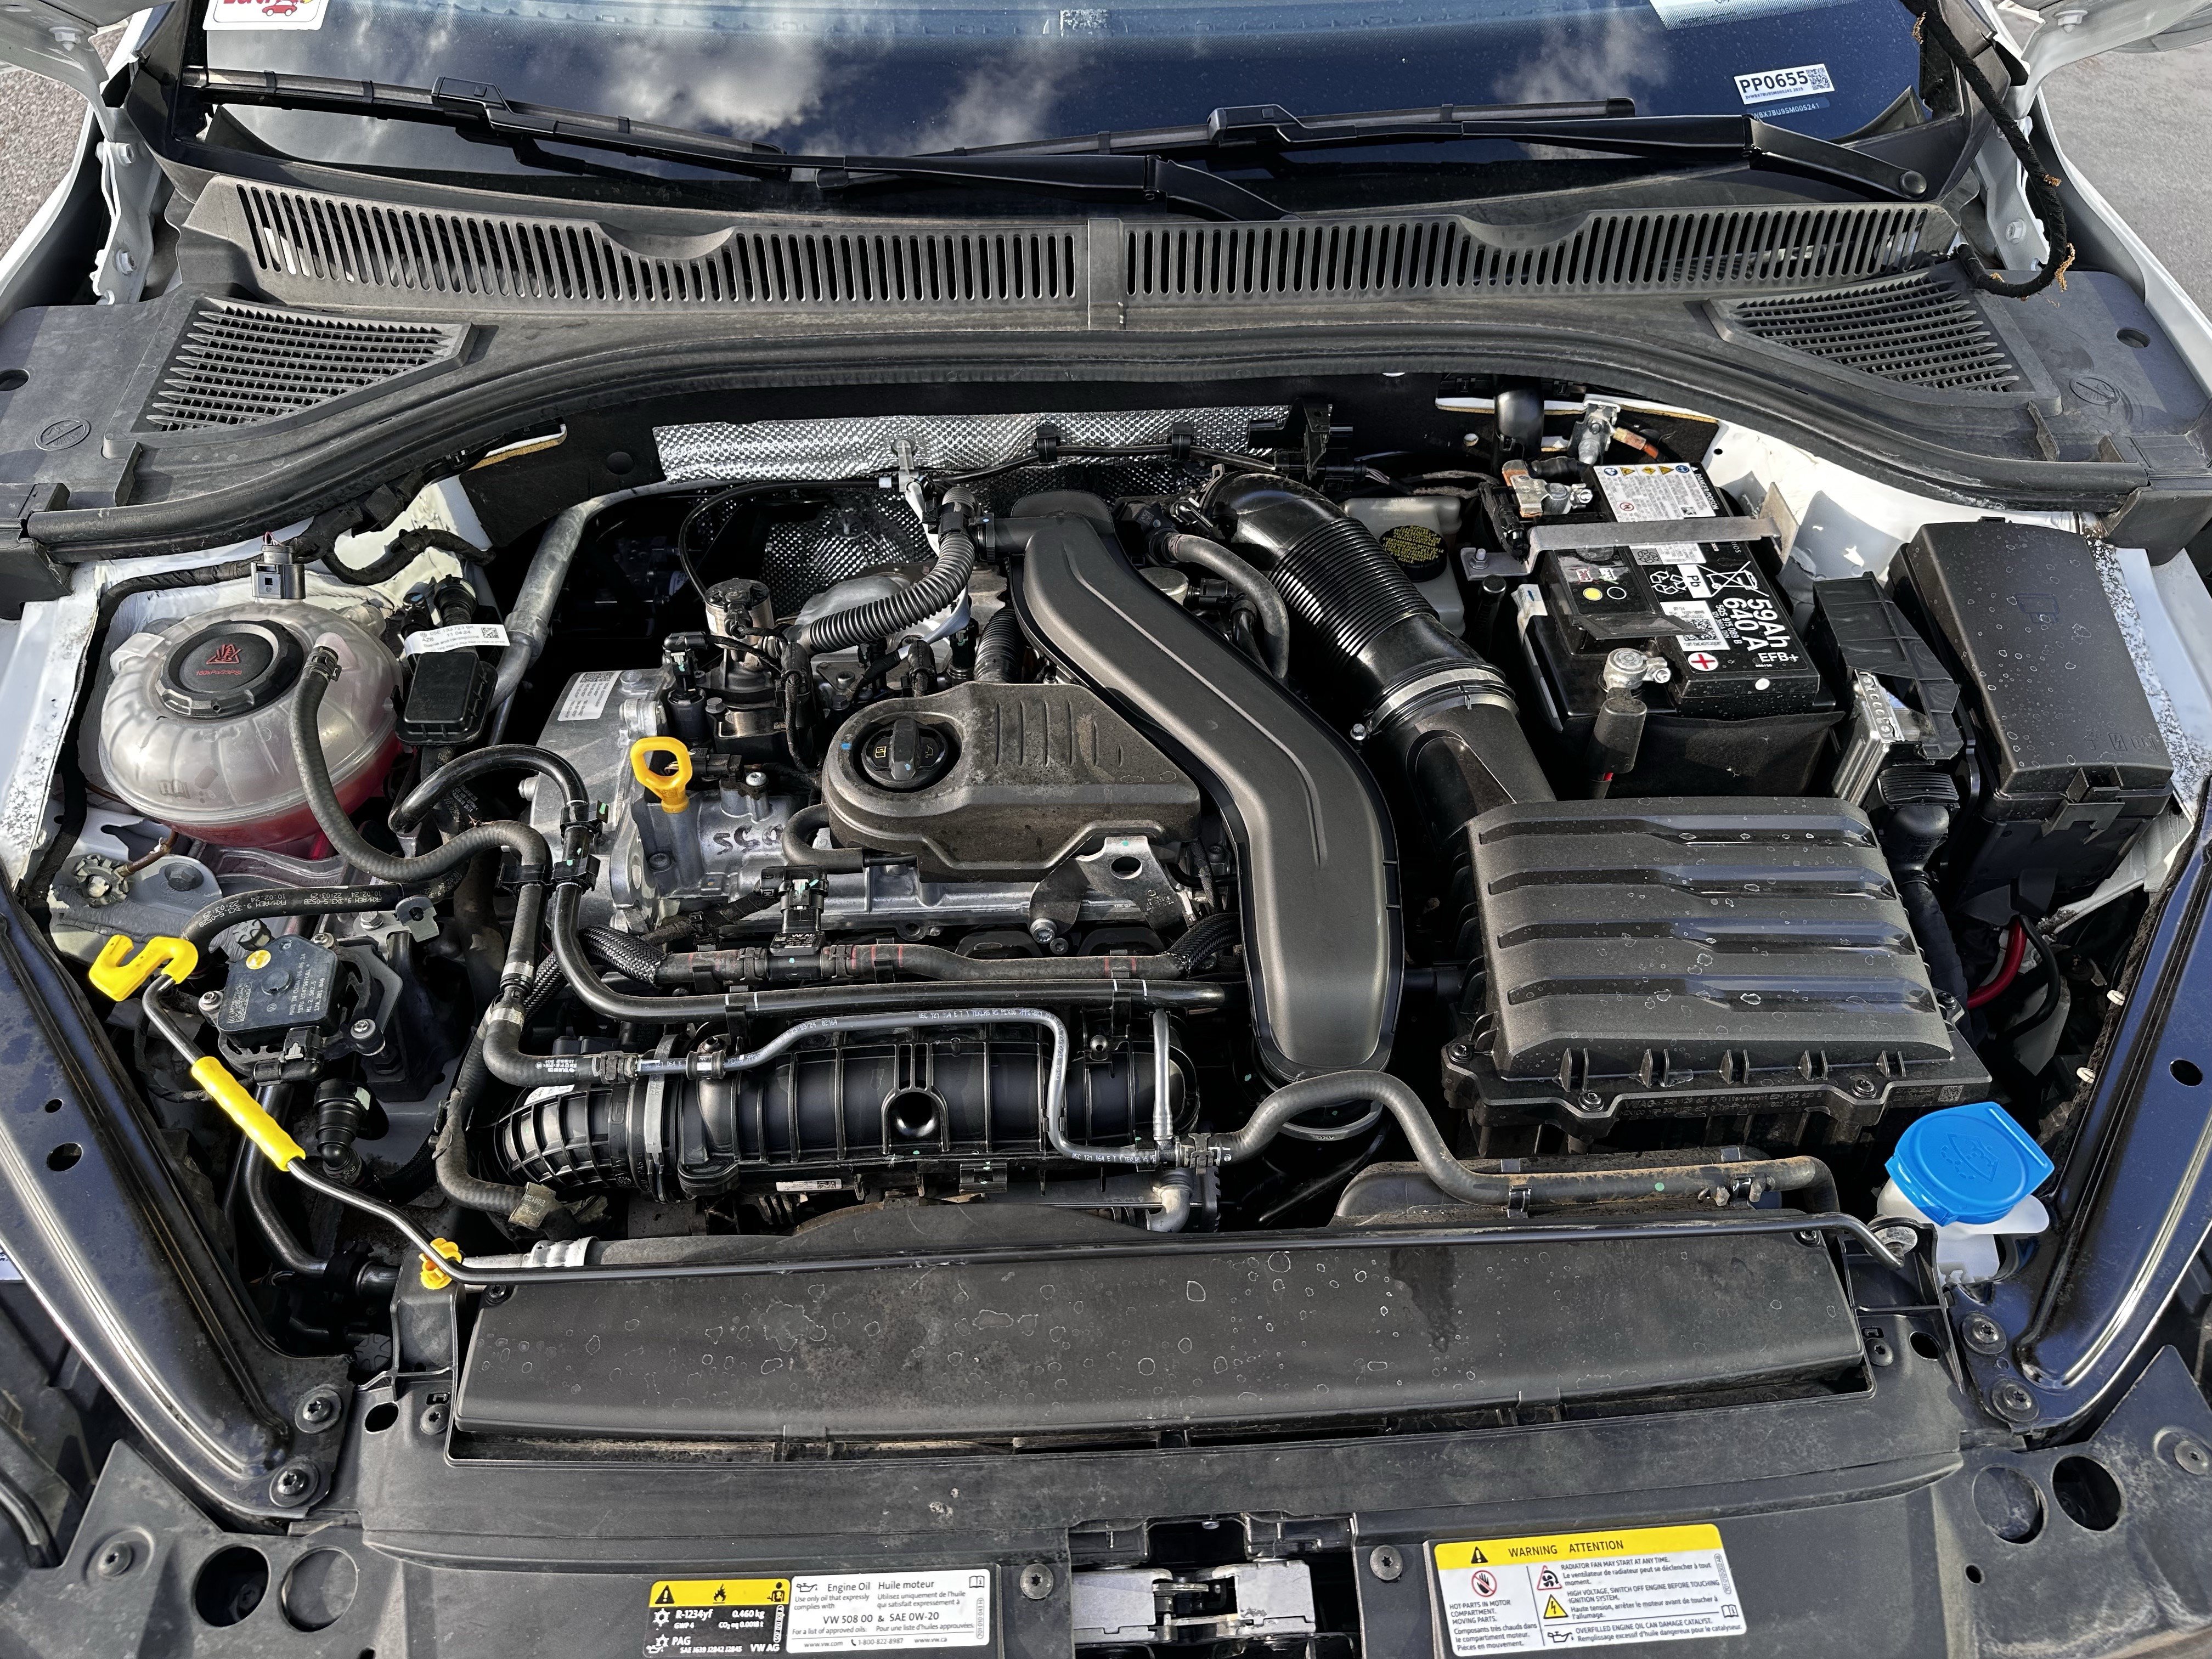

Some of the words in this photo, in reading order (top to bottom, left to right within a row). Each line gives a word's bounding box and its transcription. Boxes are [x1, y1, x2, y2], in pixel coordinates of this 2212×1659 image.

[1739, 70, 1808, 93] PP0655
[1686, 575, 1702, 589] Pb
[1723, 597, 1759, 631] 640
[1741, 636, 1769, 651] A
[1747, 599, 1791, 647] 59Ah
[1758, 652, 1798, 662] EFB+
[251, 894, 285, 903] 10.02.24
[1508, 1545, 1558, 1557] WARNING
[1569, 1540, 1624, 1553] ATTENTION
[1640, 1566, 1652, 1574] peut
[827, 1583, 856, 1594] Engine
[878, 1581, 901, 1590] Huile
[903, 1581, 934, 1589] moteur
[843, 1593, 870, 1602] expressly
[913, 1599, 955, 1607] expressément
[675, 1609, 713, 1621] R-1234yf
[755, 1610, 765, 1620] kg
[1451, 1609, 1497, 1617] COMPARTMENT.
[823, 1616, 839, 1624] VW
[842, 1615, 858, 1624] 508
[861, 1614, 873, 1623] 00
[890, 1613, 906, 1622] SAE
[909, 1612, 939, 1621] 0W-20
[826, 1626, 854, 1635] approved
[1454, 1627, 1489, 1635] Composants
[1576, 1626, 1611, 1634] OVERFILLED
[1463, 1634, 1505, 1643] compartiment
[1578, 1633, 1614, 1642] Remplissage
[1616, 1631, 1638, 1639] excessif
[1639, 1629, 1659, 1638] d'huile
[1660, 1628, 1690, 1637] dangereux
[672, 1636, 691, 1646] PAG
[750, 1644, 766, 1652] VW
[1457, 1643, 1476, 1651] Pièces
